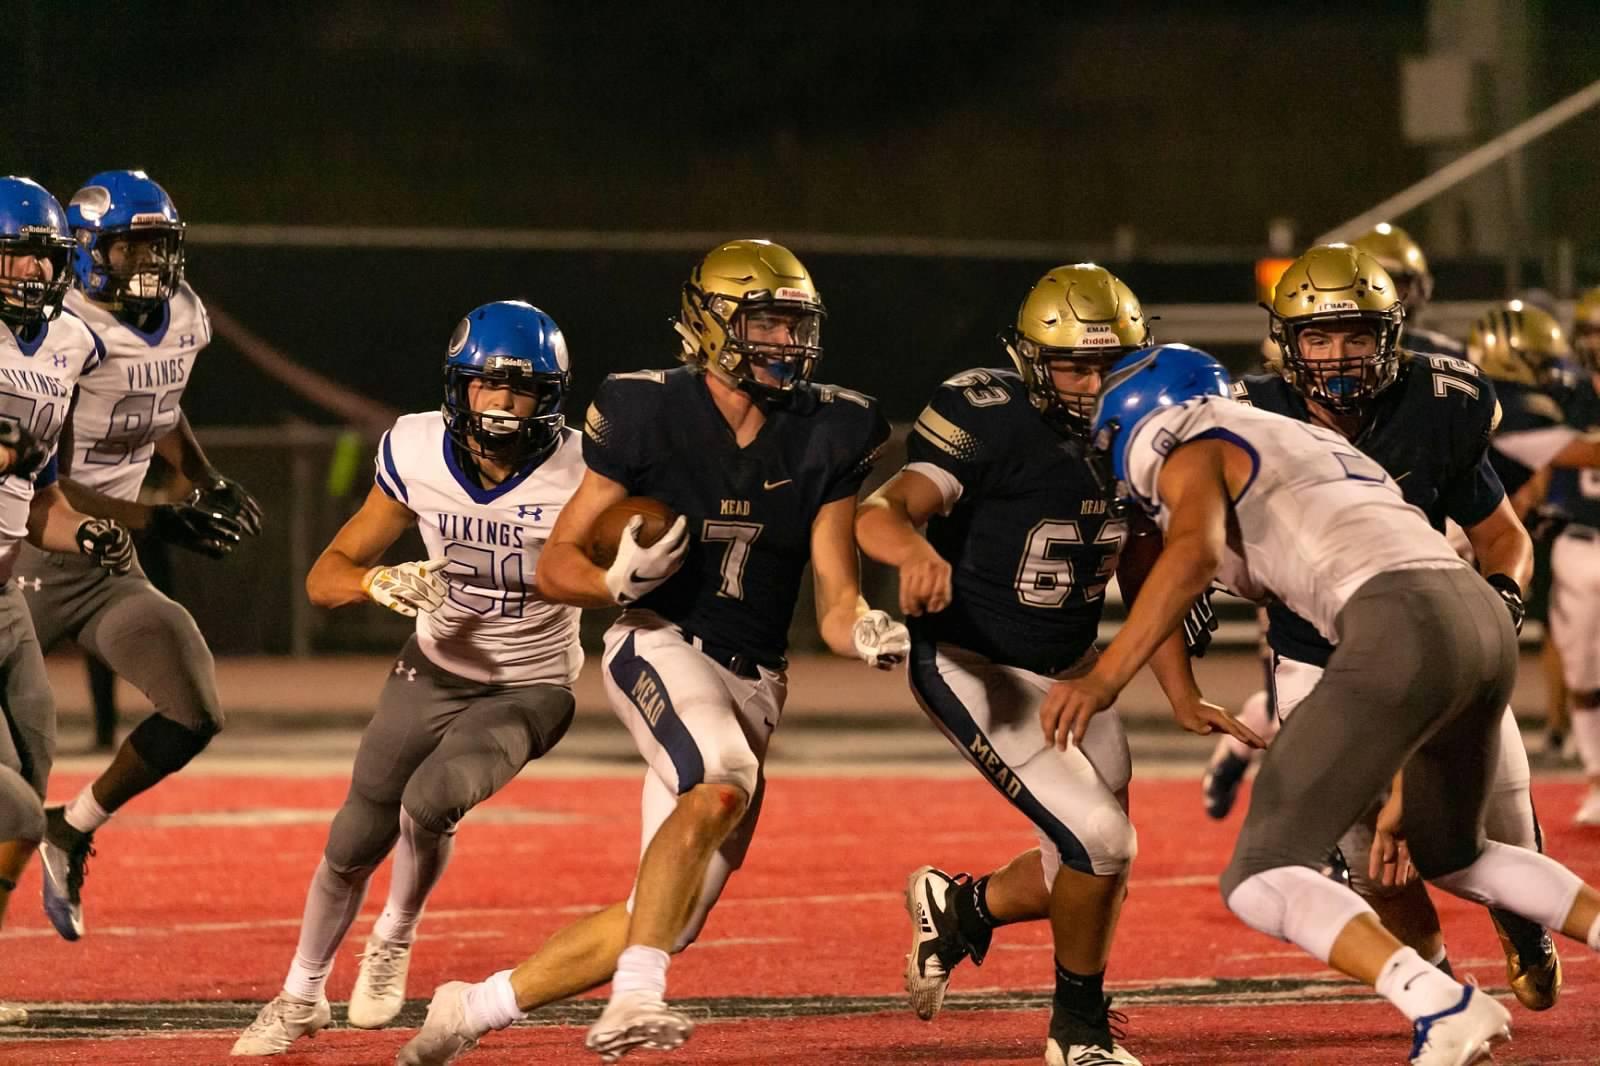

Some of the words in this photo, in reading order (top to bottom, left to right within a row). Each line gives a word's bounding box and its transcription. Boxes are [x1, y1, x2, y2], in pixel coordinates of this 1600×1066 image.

[127, 358, 186, 391] VIKINGS
[1430, 353, 1479, 400] 72
[438, 513, 524, 549] VIKINGS
[720, 498, 751, 516] MEAD
[442, 542, 525, 618] 21
[701, 519, 763, 602] 7
[1014, 518, 1127, 609] 63
[630, 669, 667, 728] MEAD
[969, 732, 1023, 800] MEAD
